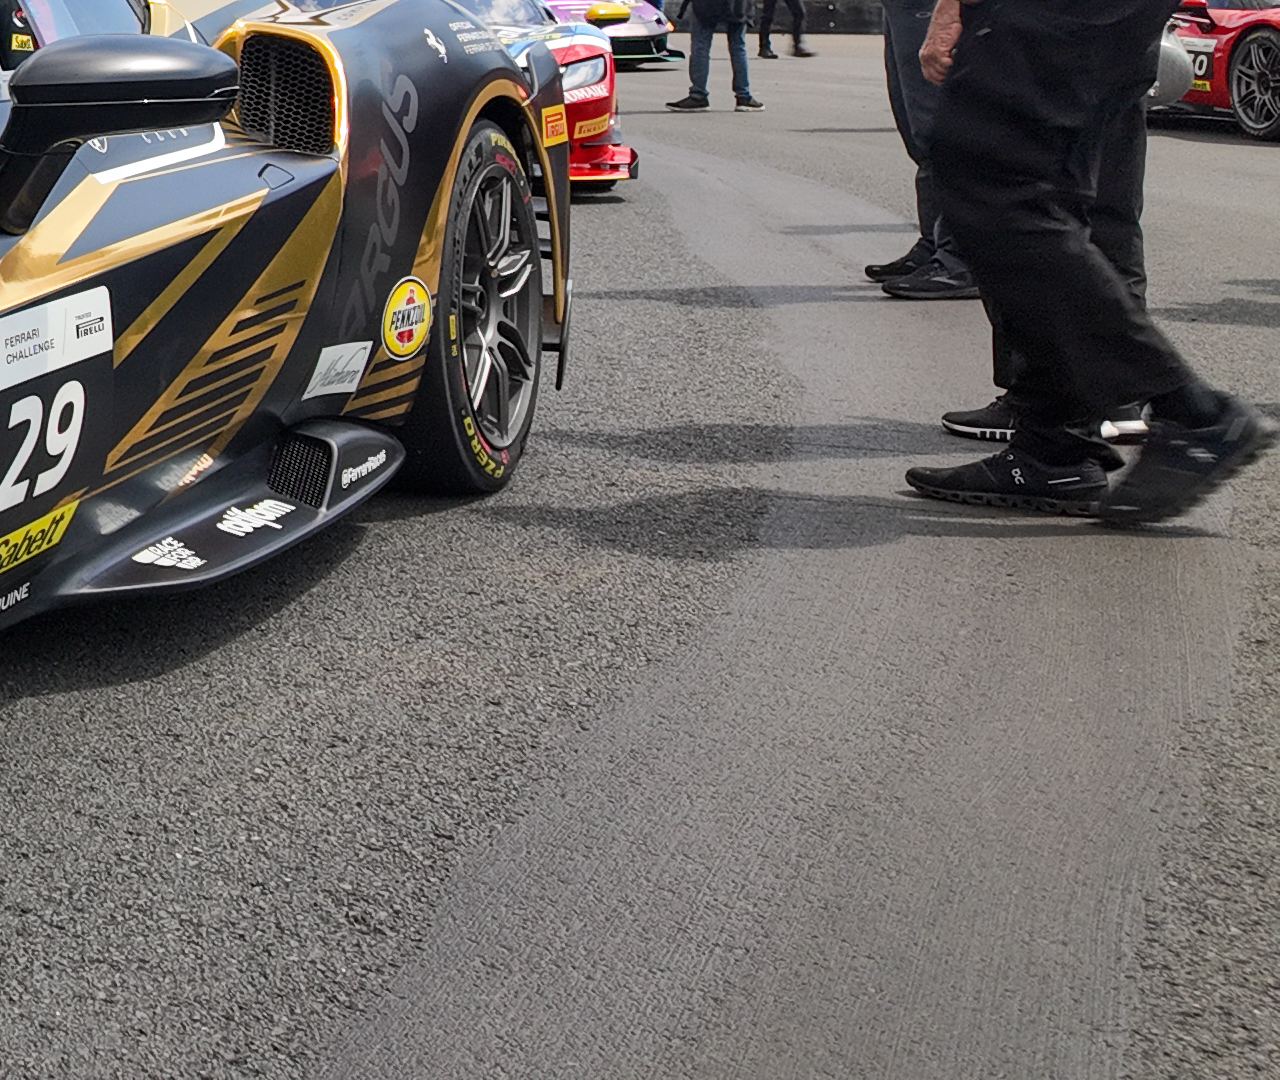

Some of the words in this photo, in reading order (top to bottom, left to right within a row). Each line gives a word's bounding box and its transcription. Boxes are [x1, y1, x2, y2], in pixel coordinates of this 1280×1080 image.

[75, 316, 105, 340] PIRELLI
[390, 303, 426, 332] PENNZOIL
[4, 327, 41, 350] FERRARI
[6, 338, 56, 365] CHALLENGE
